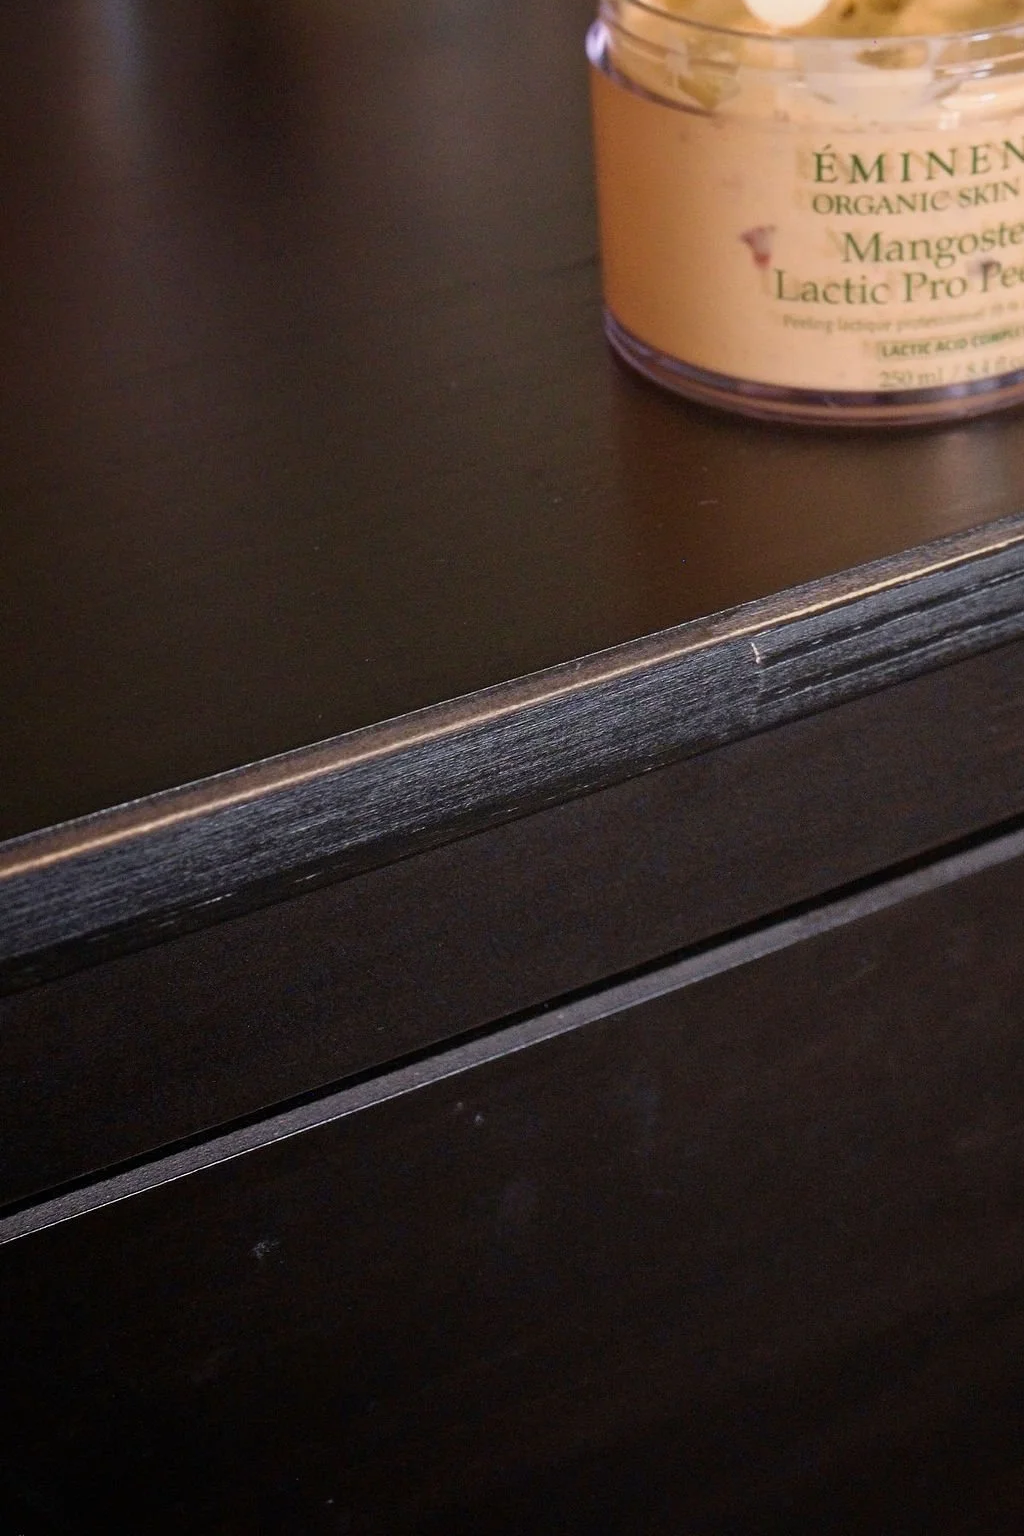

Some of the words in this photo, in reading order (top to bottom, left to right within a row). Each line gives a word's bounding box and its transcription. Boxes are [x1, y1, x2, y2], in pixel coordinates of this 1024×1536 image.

[811, 191, 951, 216] ORGANIC
[957, 179, 1020, 208] SKIN
[774, 268, 890, 305] Lactic
[902, 271, 968, 303] Pro
[881, 340, 931, 358] LACTIC
[934, 336, 968, 353] ACID
[878, 369, 913, 388] 250
